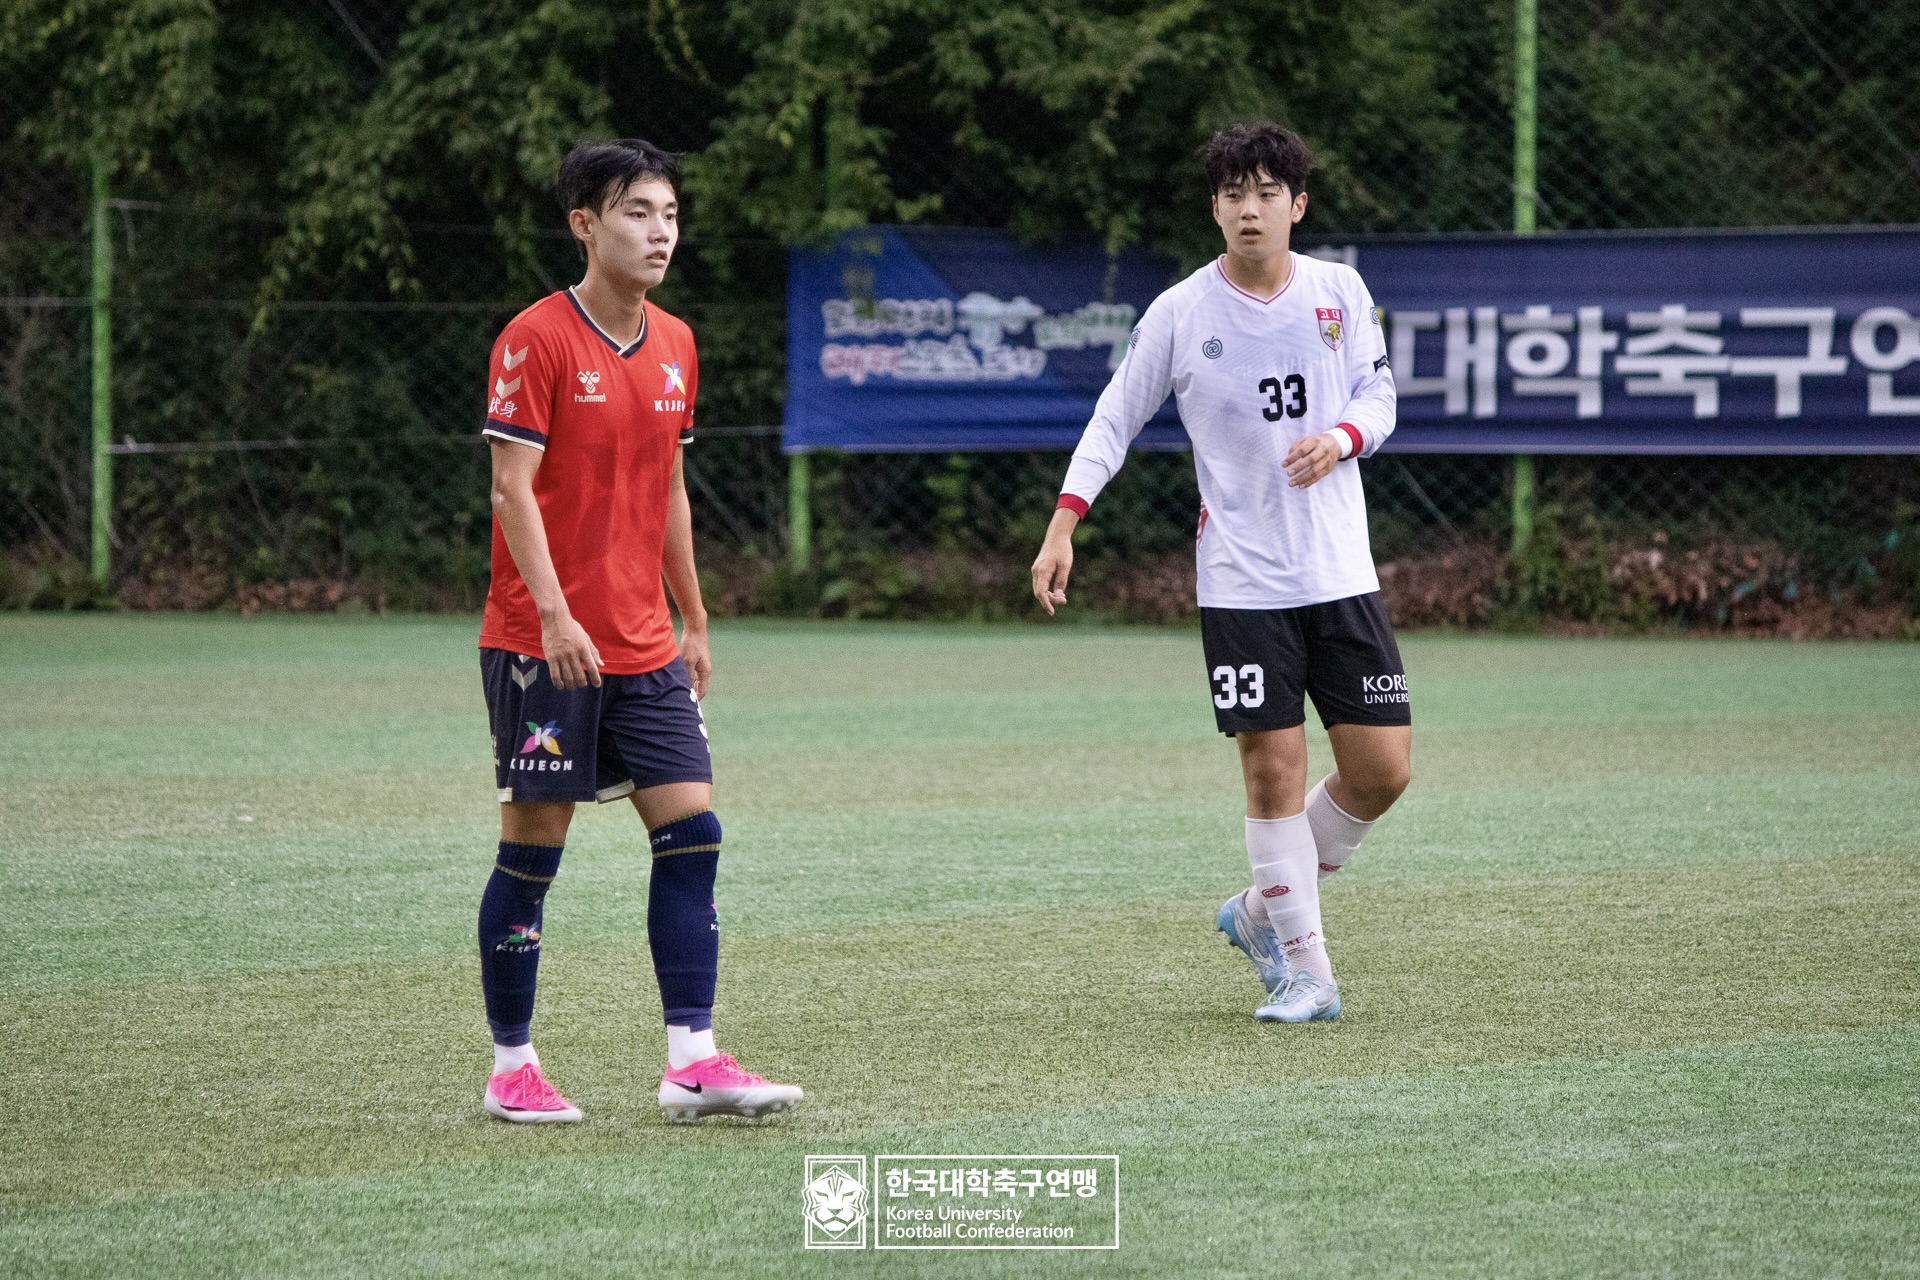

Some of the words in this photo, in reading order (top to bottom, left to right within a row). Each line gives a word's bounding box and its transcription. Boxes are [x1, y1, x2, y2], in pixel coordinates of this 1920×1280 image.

[574, 392, 607, 403] hummel
[1258, 374, 1308, 422] 33
[1213, 664, 1265, 709] 33
[510, 758, 572, 771] KIJEON
